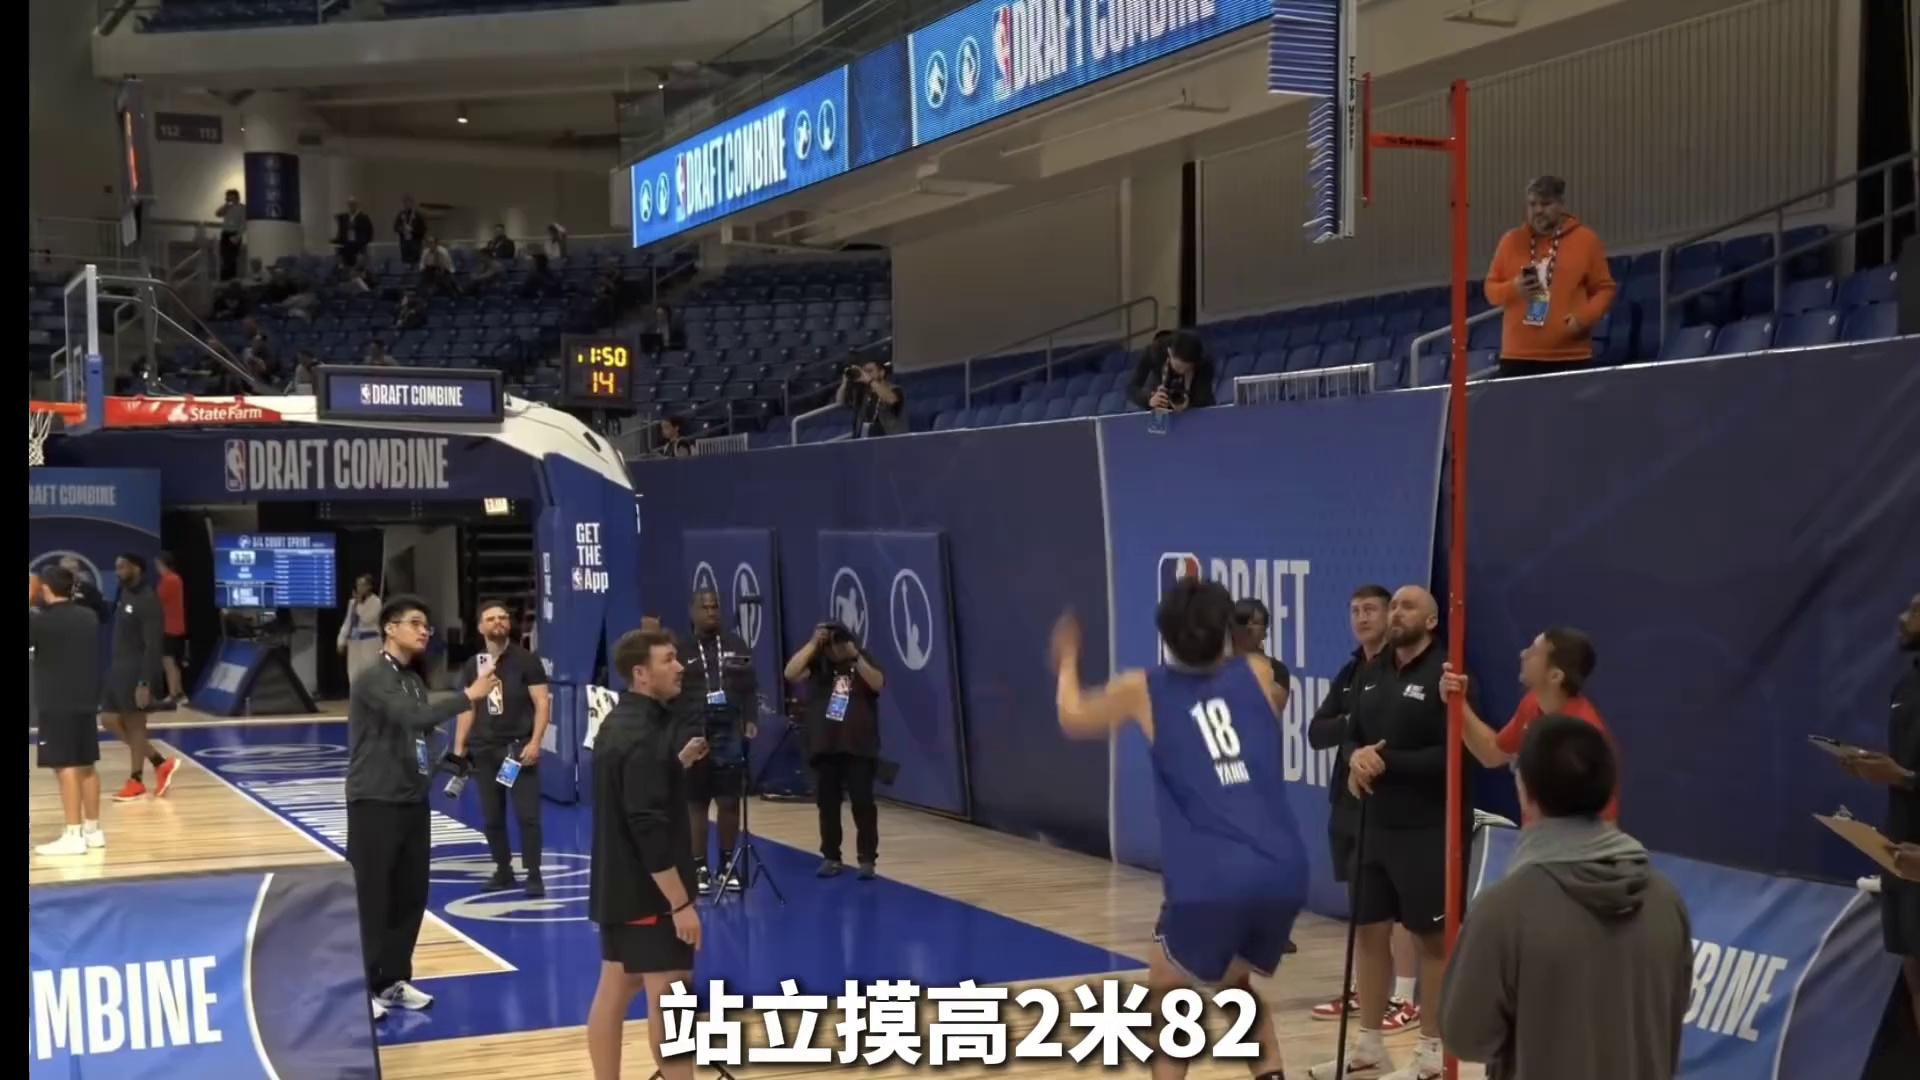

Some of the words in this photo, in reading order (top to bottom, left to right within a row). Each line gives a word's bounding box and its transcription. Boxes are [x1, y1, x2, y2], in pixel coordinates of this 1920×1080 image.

[686, 136, 724, 217] DRAFT
[724, 108, 787, 201] COMBINE
[372, 384, 409, 405] DRAFT
[411, 385, 463, 407] COMBINE
[593, 371, 614, 394] 14
[250, 439, 328, 491] DRAFT
[333, 438, 449, 490] COMBINE
[59, 485, 117, 506] COMBINE
[576, 522, 600, 544] GET
[577, 545, 602, 566] THE
[584, 567, 609, 593] App
[1189, 697, 1242, 760] 18
[1682, 938, 1789, 1042] BINE
[29, 955, 223, 1061] MBINE
